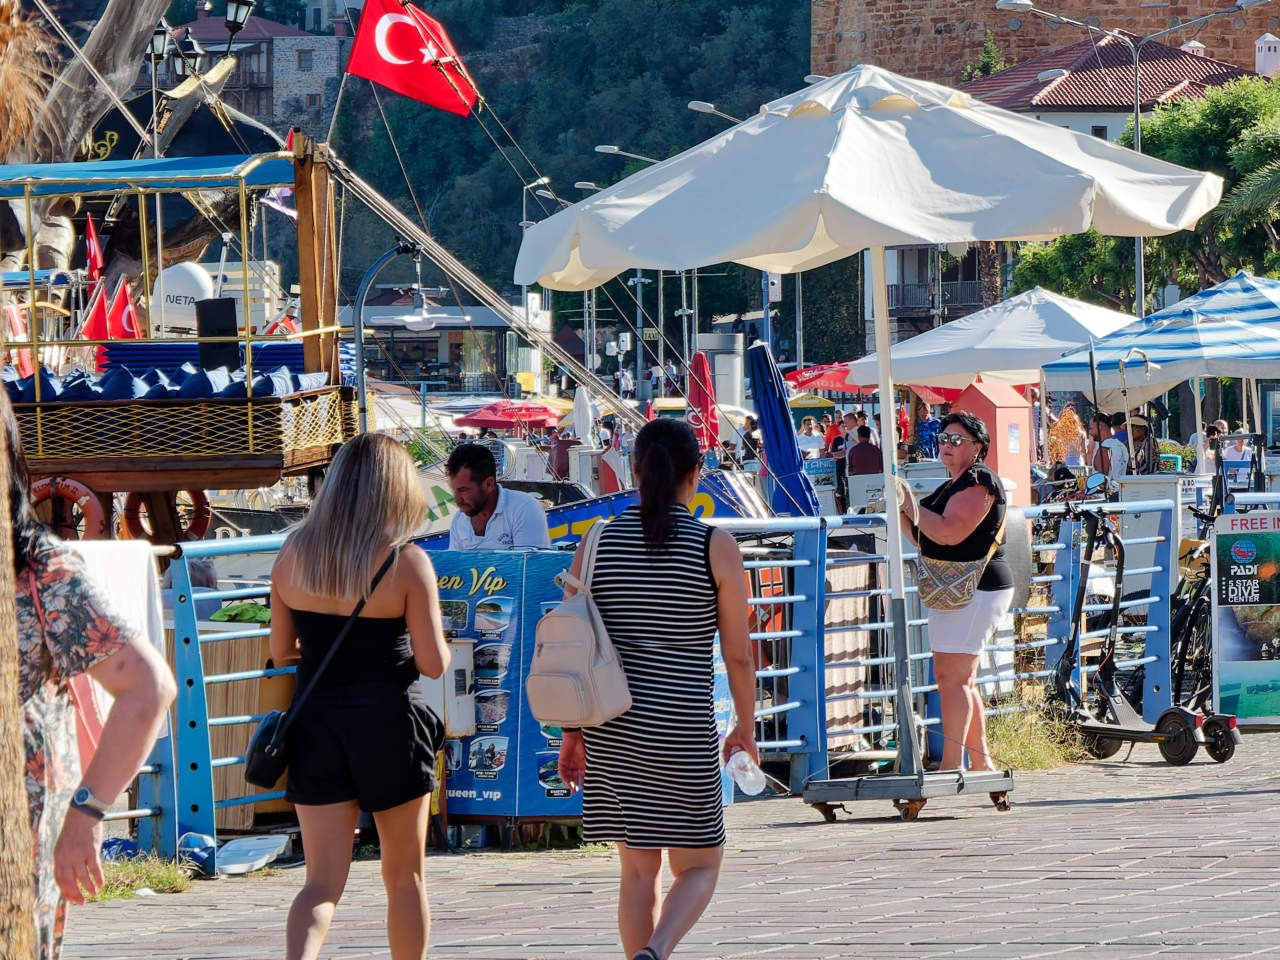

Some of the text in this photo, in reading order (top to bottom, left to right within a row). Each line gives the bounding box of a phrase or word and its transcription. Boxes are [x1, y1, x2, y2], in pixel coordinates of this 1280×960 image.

[1230, 517, 1268, 531] FREE
[1230, 564, 1259, 576] PADI
[469, 566, 507, 595] Vip
[1228, 579, 1259, 587] 5 STAR
[1228, 586, 1260, 598] DIVE
[1228, 595, 1260, 603] CENTER
[446, 790, 501, 801] ueen_vip
